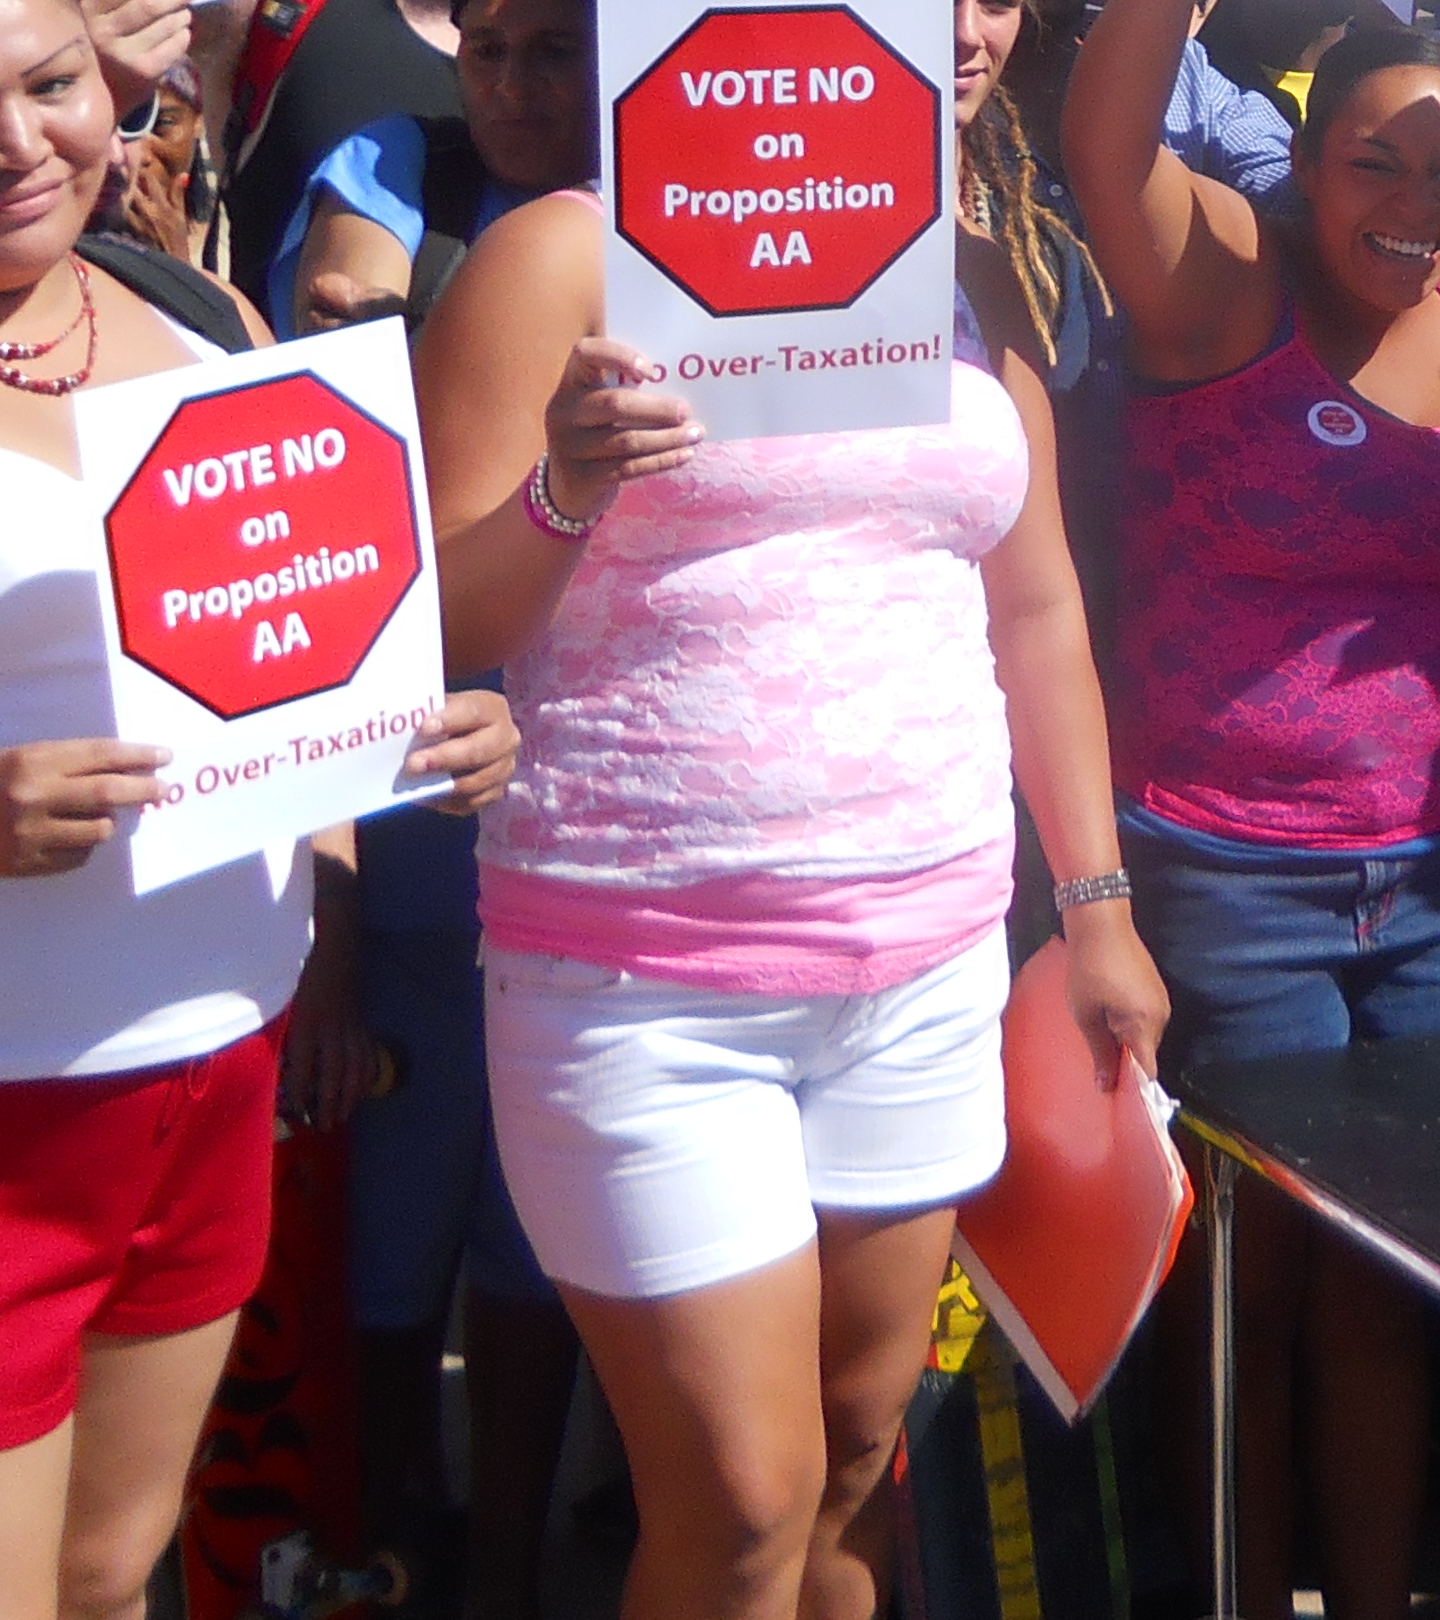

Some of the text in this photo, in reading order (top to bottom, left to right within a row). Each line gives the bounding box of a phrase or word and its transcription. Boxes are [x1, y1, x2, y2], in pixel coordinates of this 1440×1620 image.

[680, 65, 875, 106] VOTE NO
[754, 132, 804, 159] on
[663, 177, 895, 223] Proposition
[750, 231, 812, 268] AA
[678, 335, 942, 383] Over-Taxation!
[163, 428, 346, 507] VOTE NO
[240, 511, 290, 546] on
[162, 542, 379, 628] Proposition
[252, 612, 311, 662] AA
[195, 695, 437, 796] Over-Taxation!
